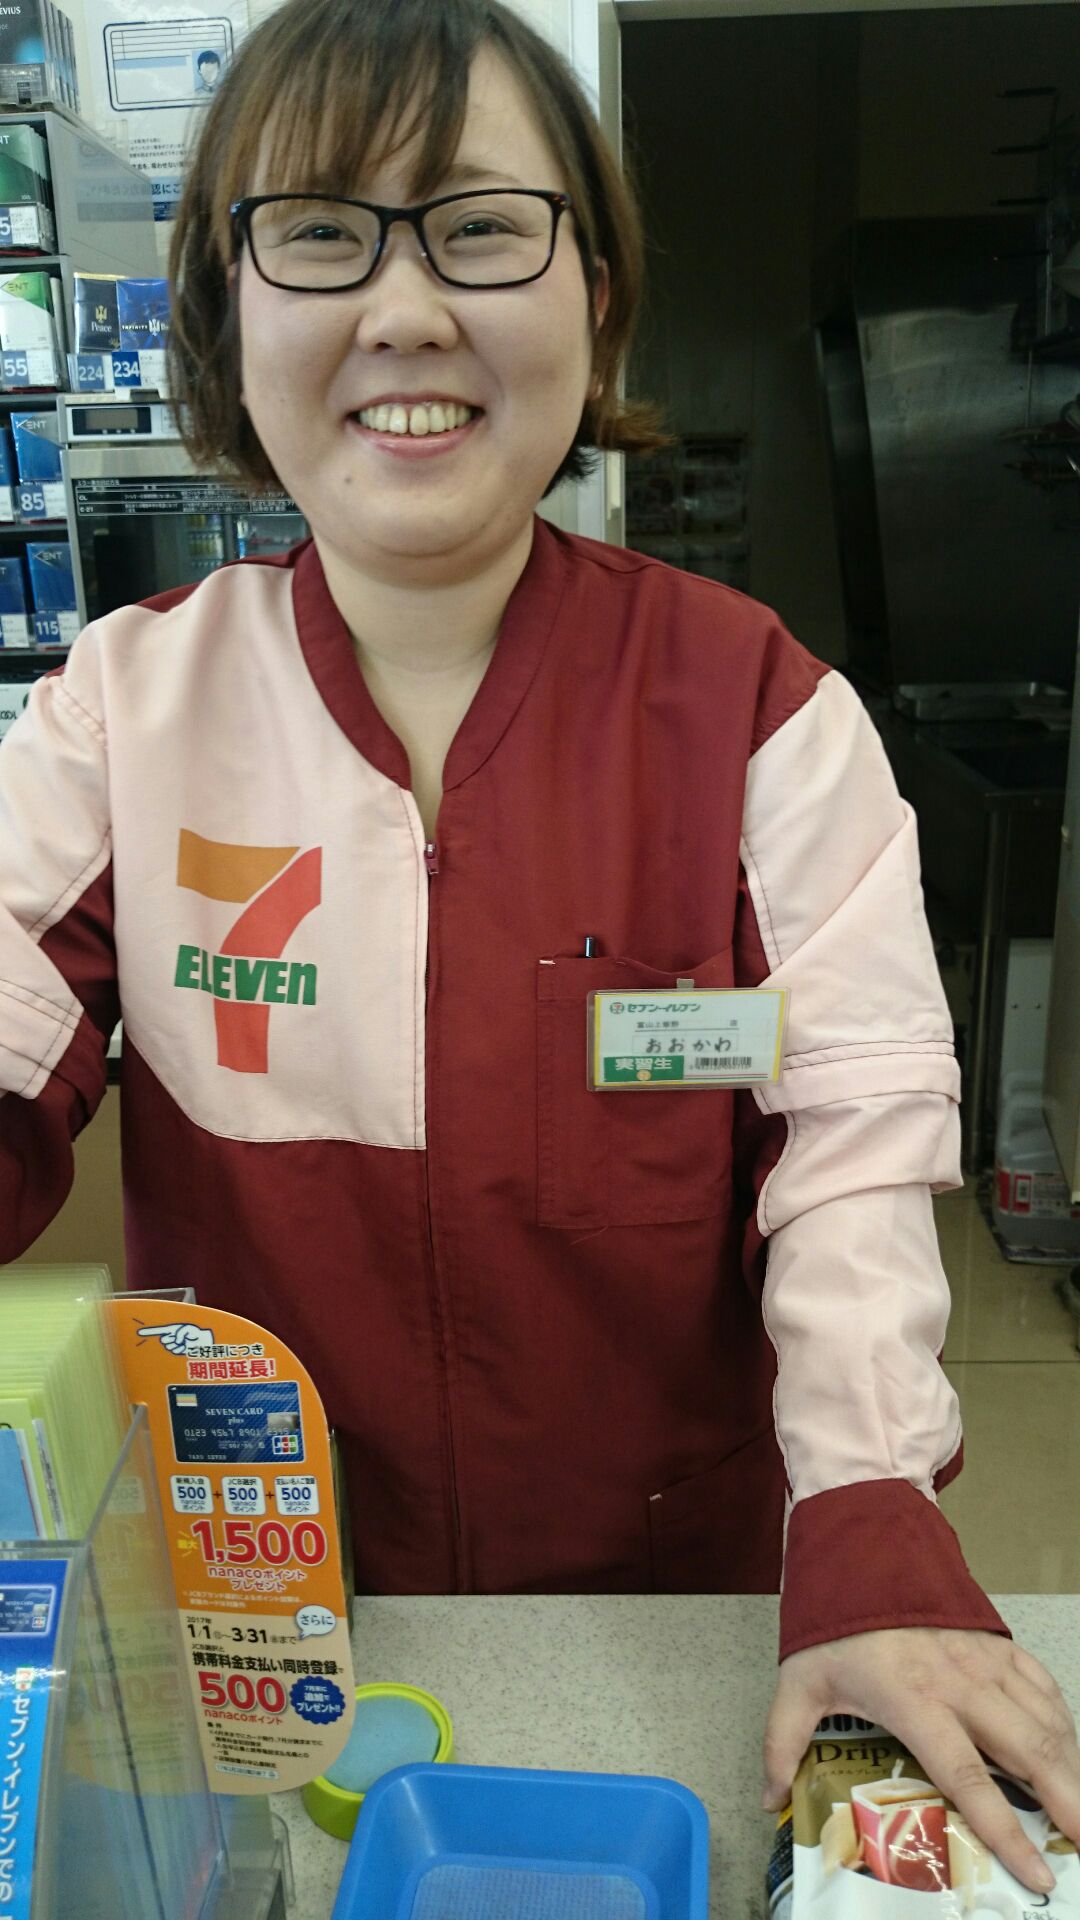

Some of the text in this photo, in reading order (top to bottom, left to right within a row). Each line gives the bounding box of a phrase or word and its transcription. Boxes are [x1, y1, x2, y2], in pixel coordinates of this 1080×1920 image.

[91, 321, 113, 333] Peace
[4, 358, 28, 378] 55
[79, 365, 104, 382] 224
[112, 360, 140, 378] 234
[15, 420, 47, 430] KENT
[21, 492, 45, 512] 85
[32, 551, 63, 560] KENT
[35, 621, 59, 636] 115
[176, 827, 322, 1073] 7
[615, 1057, 673, 1071] 実習生
[187, 1343, 263, 1358] ご好評につき
[205, 1407, 264, 1416] SEVEN CARD
[177, 1486, 207, 1500] 500
[228, 1487, 258, 1501] 500
[281, 1487, 312, 1501] 500
[192, 1519, 327, 1566] 1,500
[231, 1579, 287, 1592] プレゼント
[300, 1614, 334, 1626] さらに
[198, 1671, 287, 1714] 500
[814, 1742, 891, 1767] Drip
